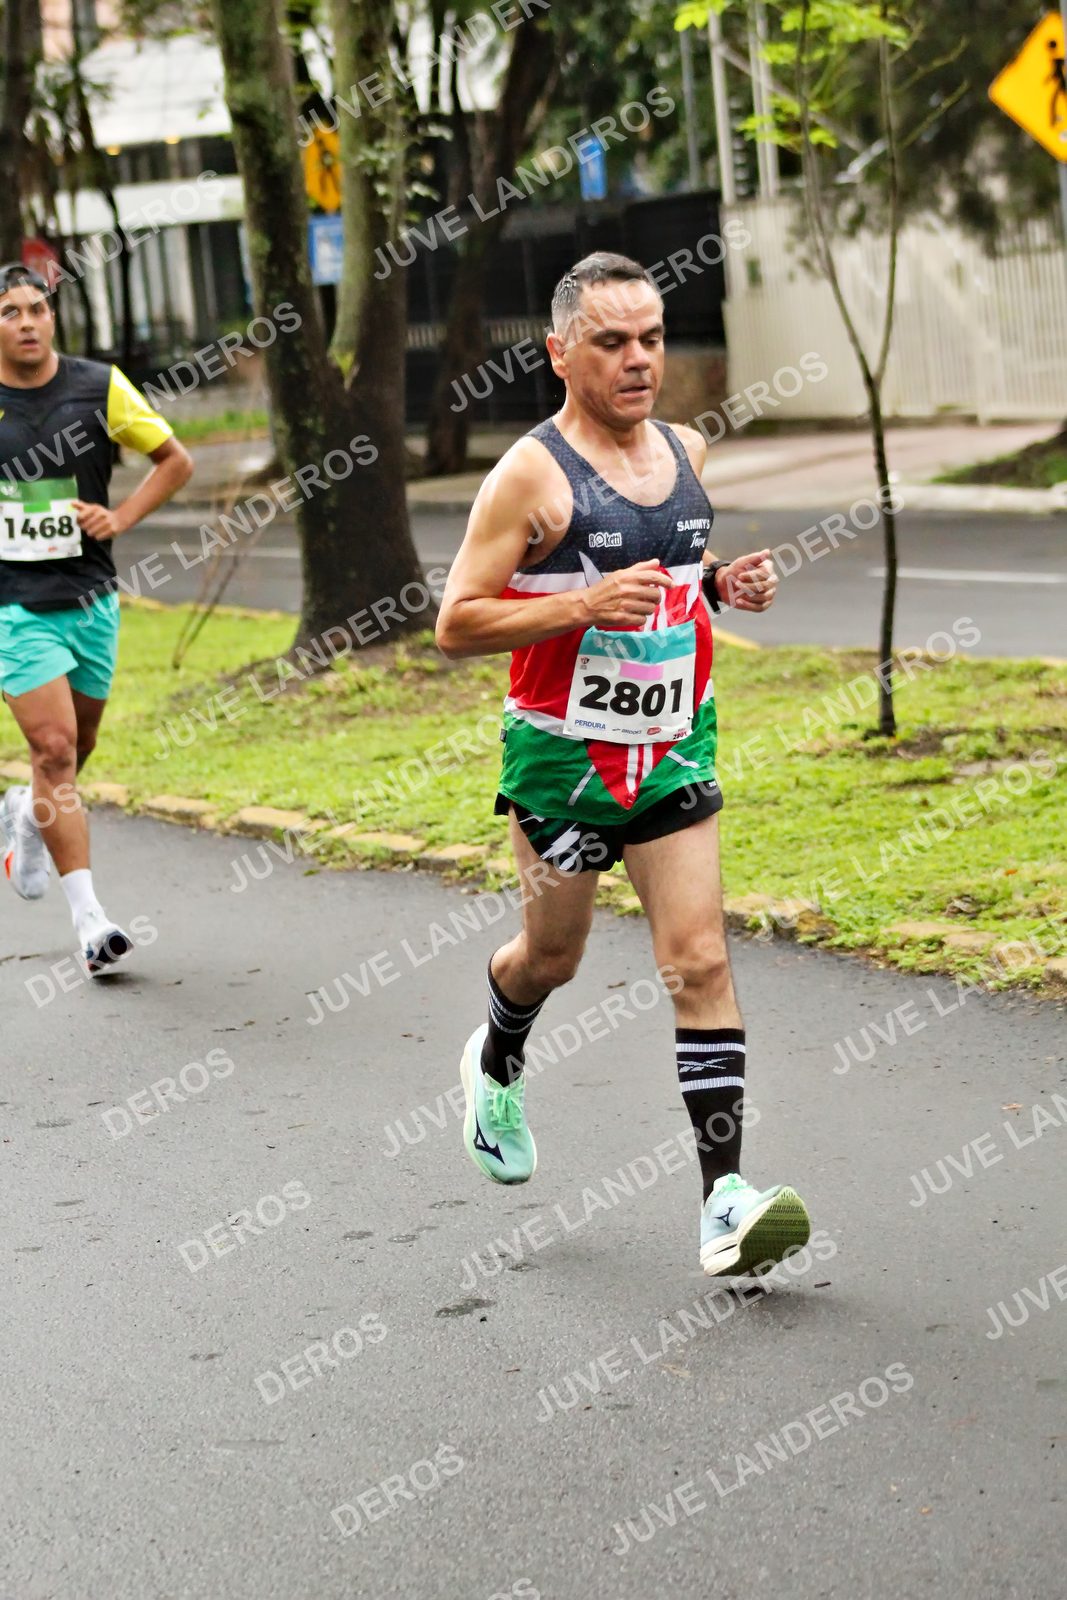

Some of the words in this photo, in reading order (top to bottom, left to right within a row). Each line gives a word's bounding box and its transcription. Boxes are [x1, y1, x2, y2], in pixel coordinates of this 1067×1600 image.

[4, 515, 74, 540] 1468
[579, 675, 683, 717] 2801
[575, 719, 606, 730] PERDURA
